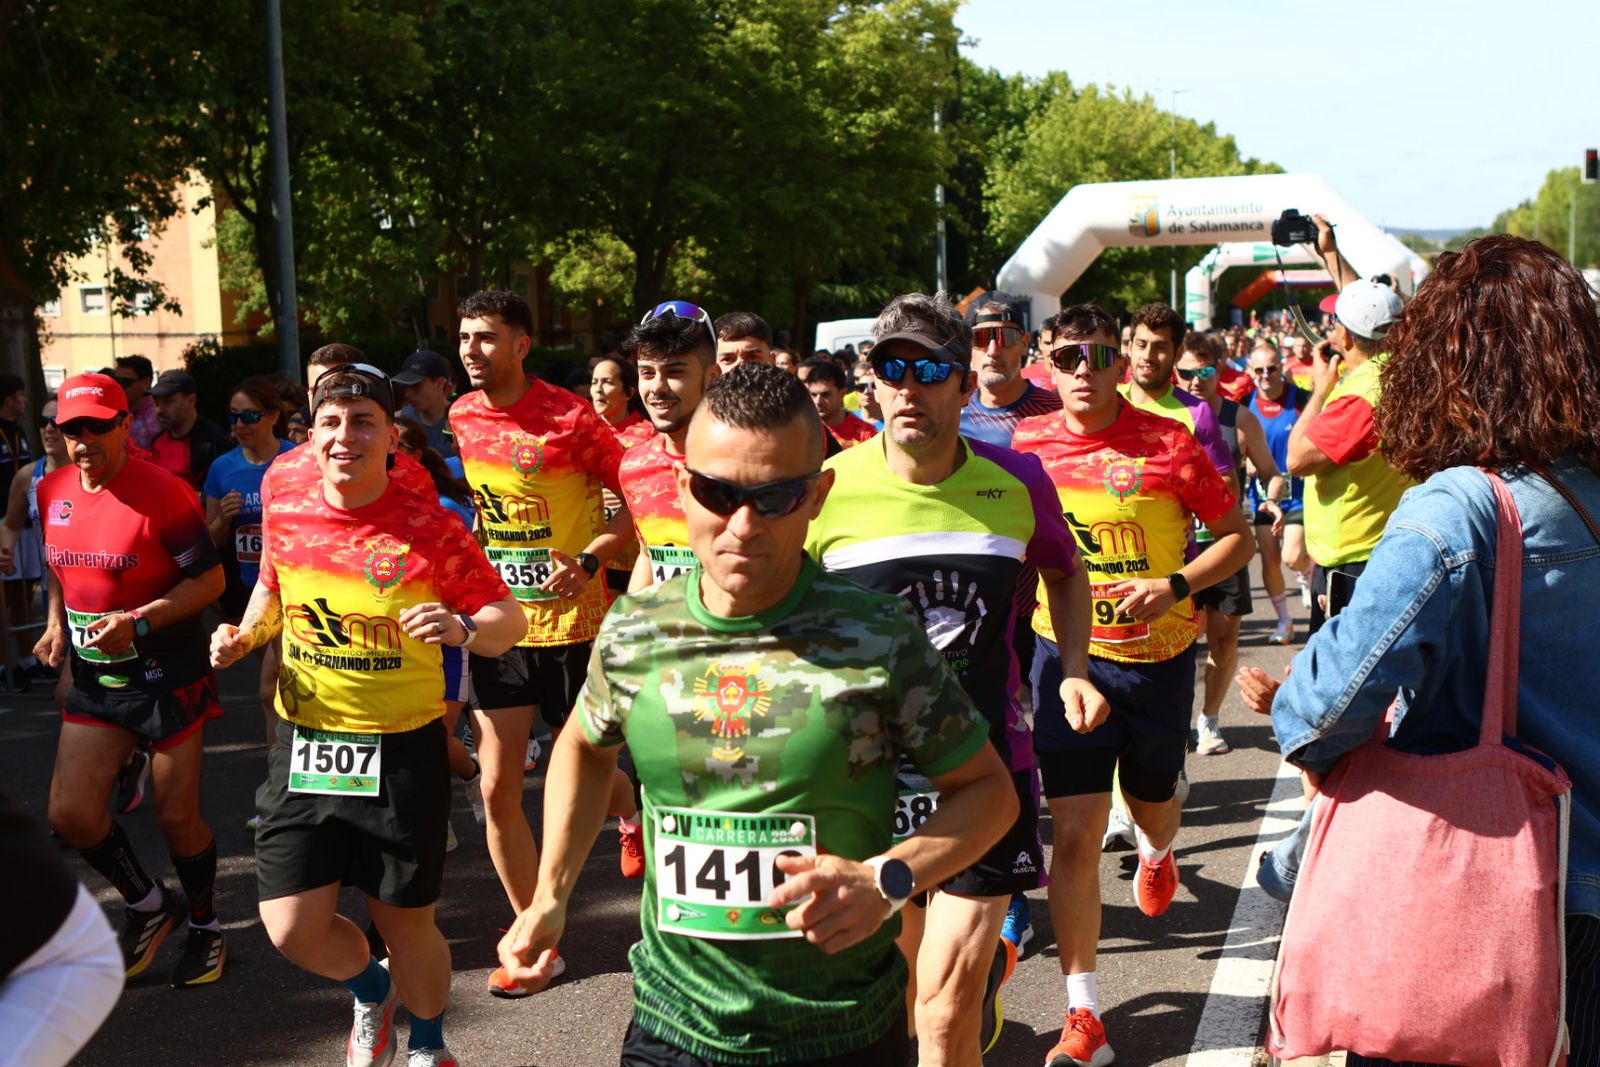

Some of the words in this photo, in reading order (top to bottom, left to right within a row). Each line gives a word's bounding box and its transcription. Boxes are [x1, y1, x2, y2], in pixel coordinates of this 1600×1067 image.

[1168, 203, 1263, 219] Ayuntamiento
[1168, 222, 1184, 234] de
[1190, 219, 1264, 233] Salamanca
[488, 528, 527, 542] FERNANDO
[49, 545, 139, 569] Cabrerizos
[488, 550, 503, 560] XIV
[649, 549, 664, 562] XIV
[1085, 559, 1124, 574] RNANDO
[495, 563, 549, 587] 1358
[1095, 599, 1135, 625] 92
[314, 653, 370, 671] FERNANDO
[373, 657, 402, 671] 2026
[145, 668, 163, 680] MSC
[297, 742, 377, 774] 1507
[893, 795, 942, 835] 68
[696, 816, 721, 829] SAN
[734, 818, 806, 832] FERNAN
[696, 828, 767, 844] CARRERA
